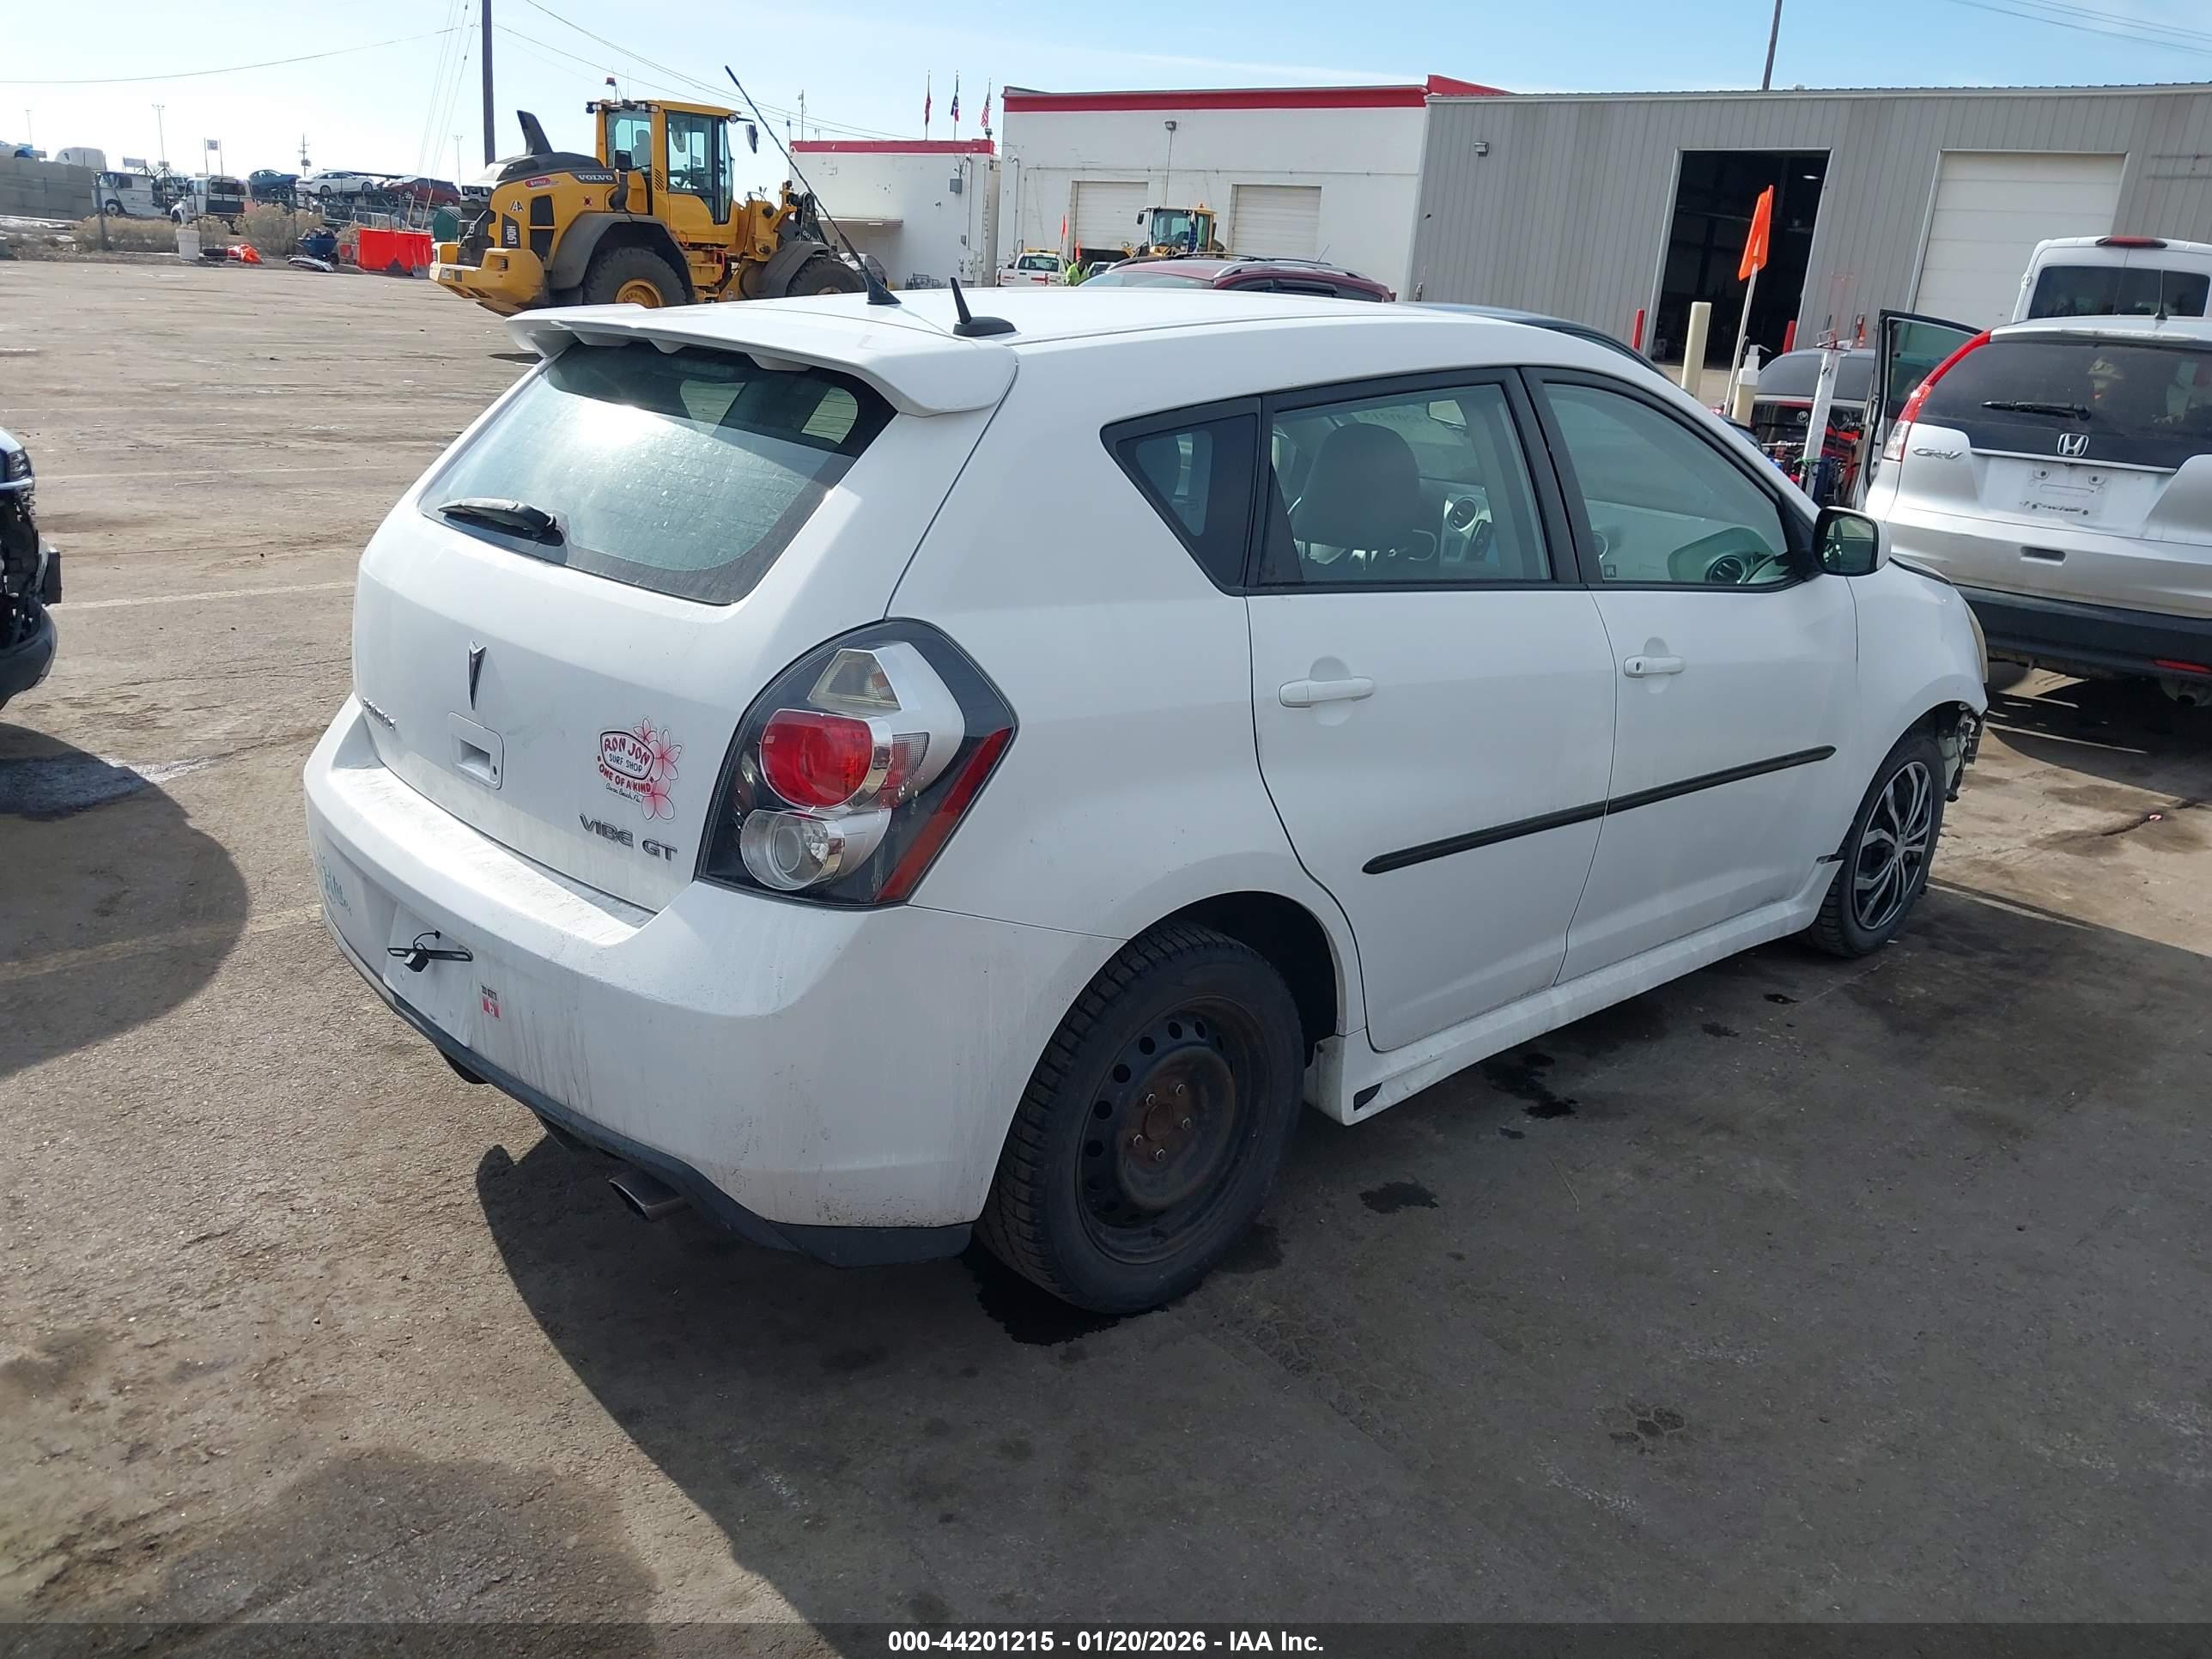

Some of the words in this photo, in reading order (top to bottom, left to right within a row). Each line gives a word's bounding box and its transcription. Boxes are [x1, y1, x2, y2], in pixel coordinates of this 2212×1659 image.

[507, 225, 517, 245] L90H
[604, 737, 626, 752] RON
[628, 742, 651, 766] JON
[609, 753, 623, 766] SURF
[625, 759, 643, 773] SHOP
[599, 763, 613, 781] ONE
[615, 775, 625, 787] OF
[626, 780, 631, 790] A
[633, 782, 651, 793] KIND
[579, 813, 634, 848] VIBE
[641, 838, 678, 861] GT
